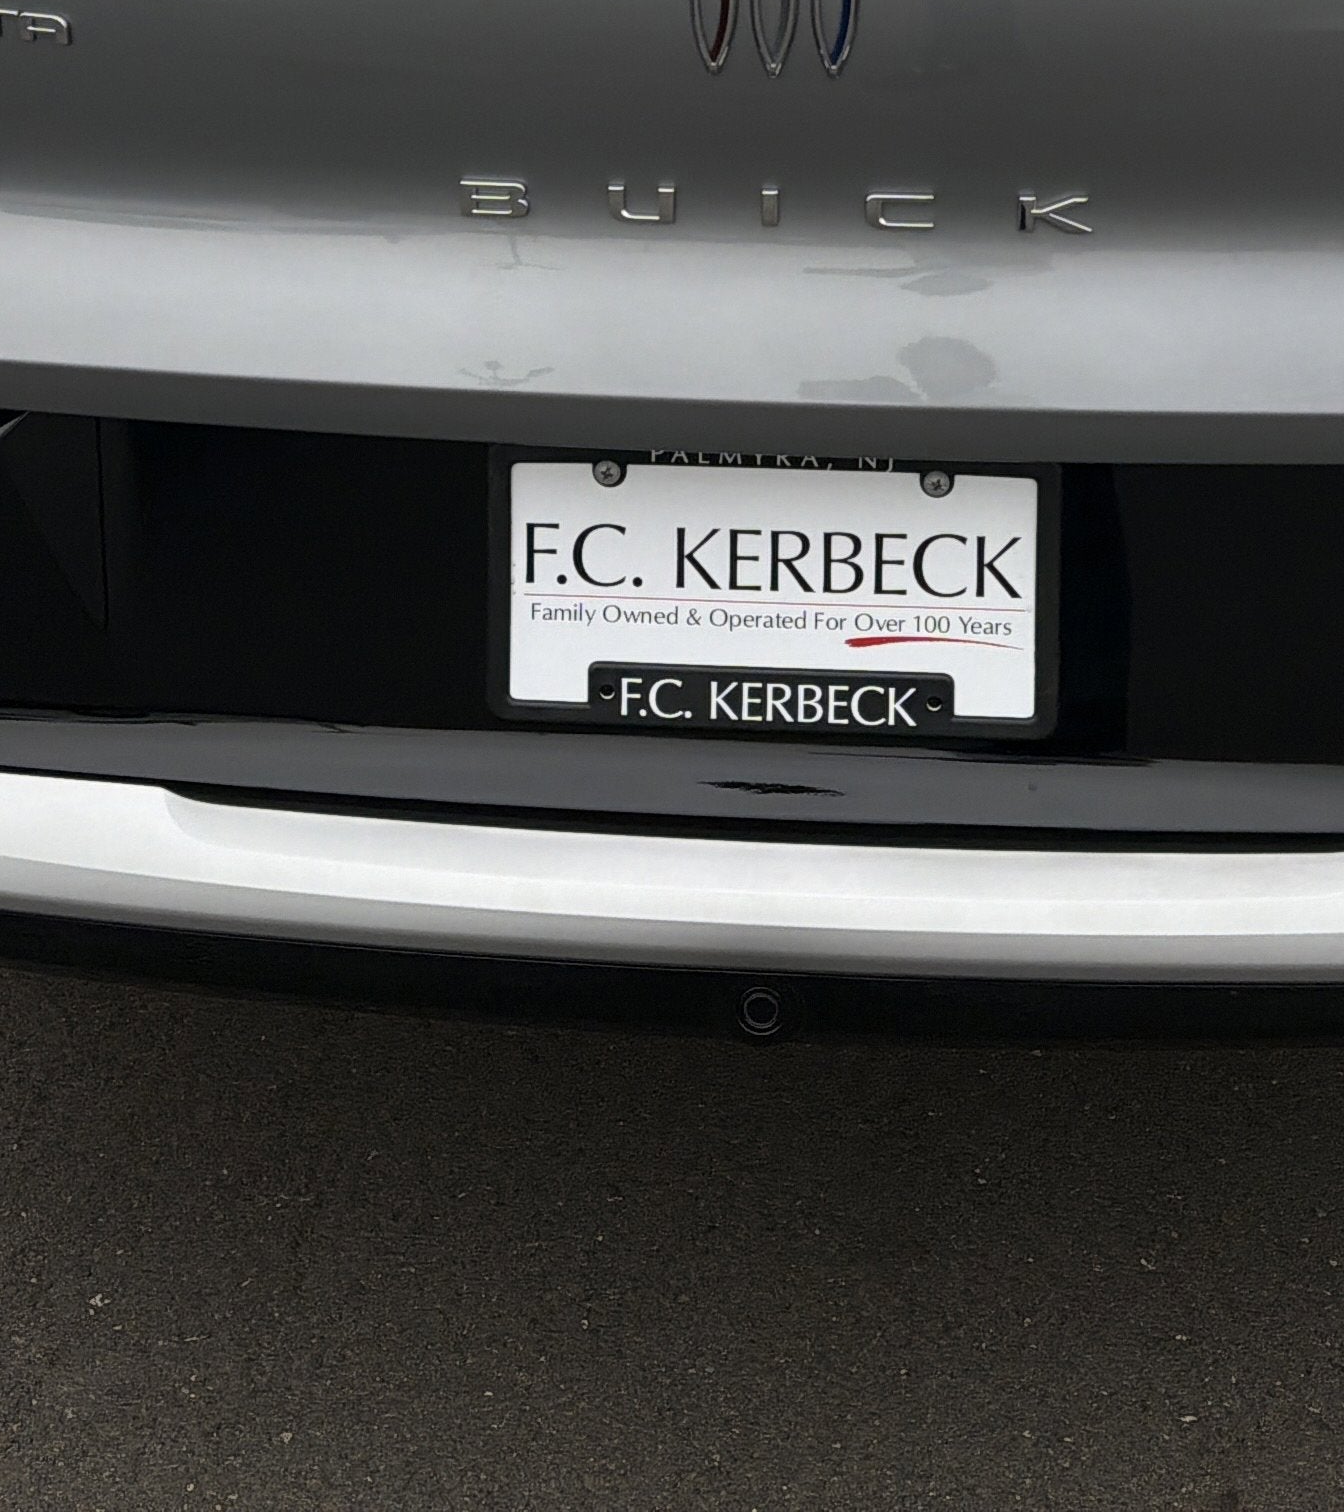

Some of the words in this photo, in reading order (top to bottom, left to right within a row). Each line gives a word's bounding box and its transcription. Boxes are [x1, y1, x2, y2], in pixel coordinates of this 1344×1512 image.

[460, 177, 1093, 232] BUICK
[858, 457, 895, 473] NJ
[524, 522, 644, 588] F.C.
[675, 527, 1022, 599] KERBECK
[531, 602, 596, 626] Family
[603, 604, 679, 625] Owned
[686, 608, 703, 626] &
[709, 608, 807, 632] Operated
[815, 612, 847, 631] For
[855, 613, 906, 633] Over
[914, 615, 951, 634] 100
[959, 616, 1013, 636] Years
[620, 677, 693, 719] F.C.
[709, 681, 917, 727] KERBECK
